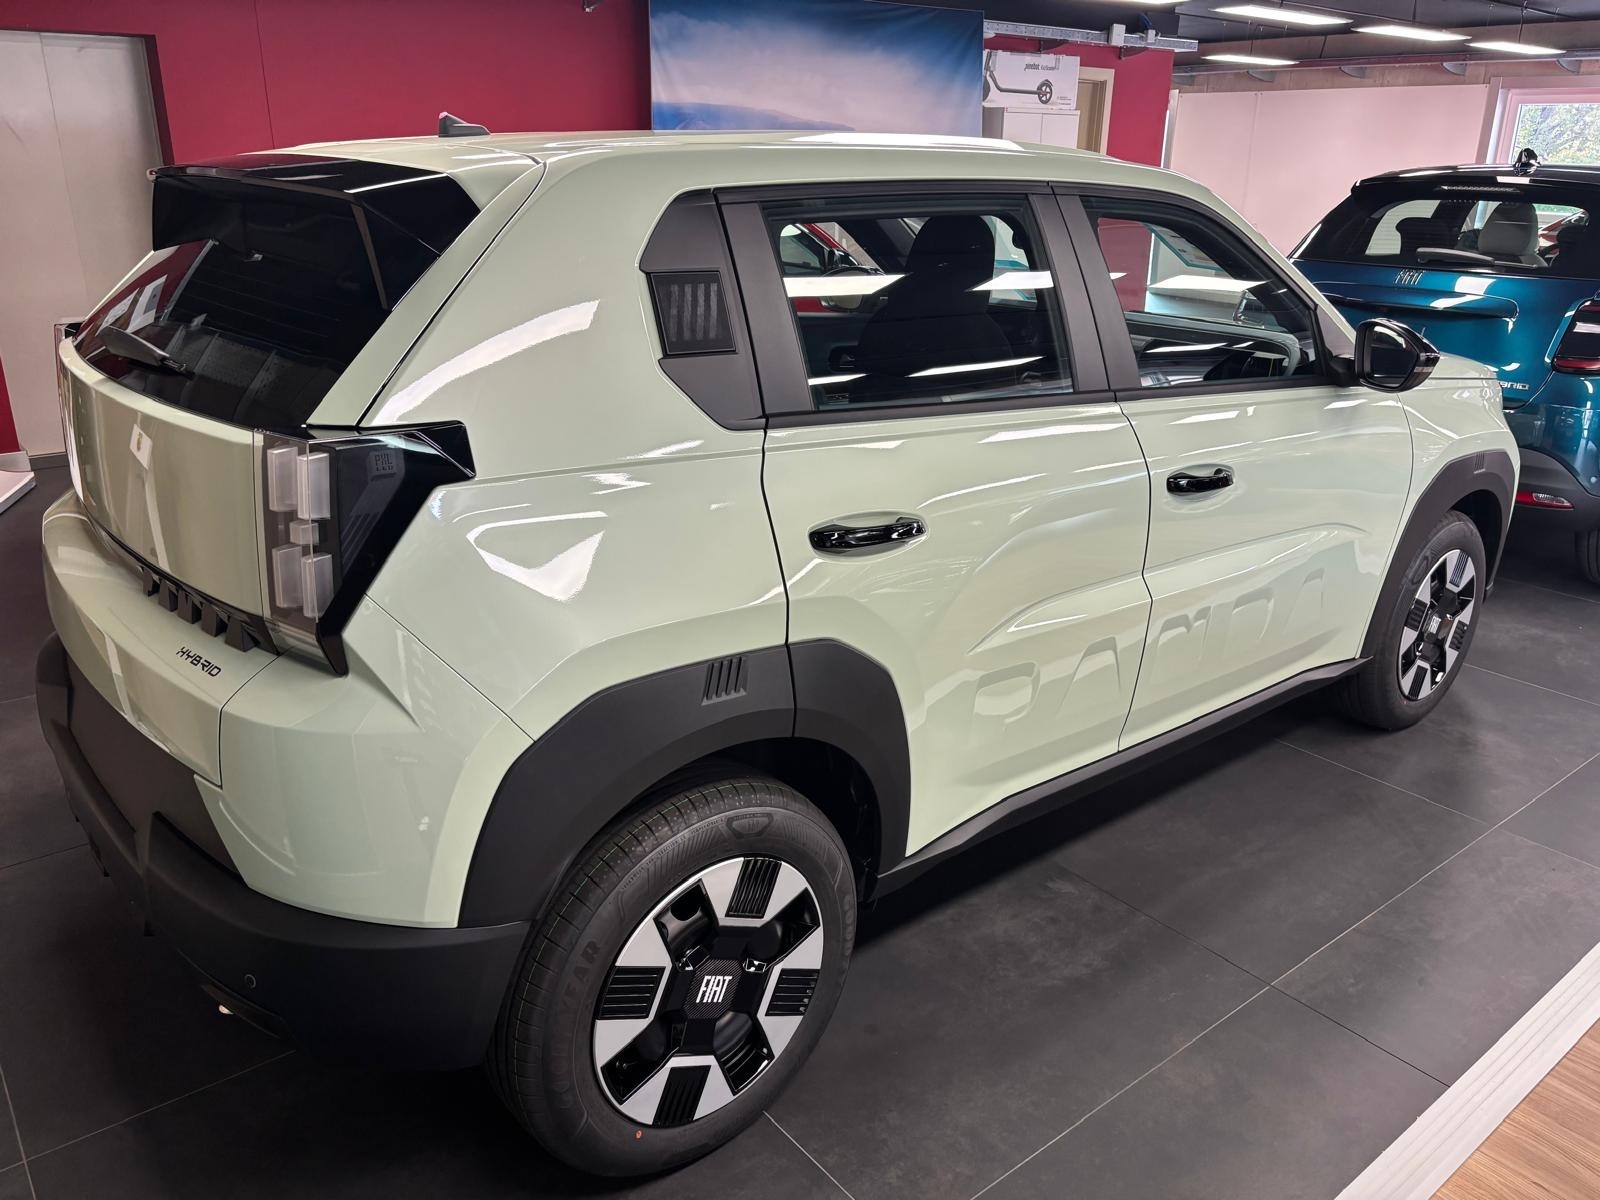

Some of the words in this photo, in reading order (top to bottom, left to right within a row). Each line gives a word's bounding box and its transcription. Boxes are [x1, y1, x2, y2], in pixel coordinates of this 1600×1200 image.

[1498, 380, 1530, 390] BRID
[176, 646, 222, 677] HYBRID
[696, 976, 732, 1003] FIAT
